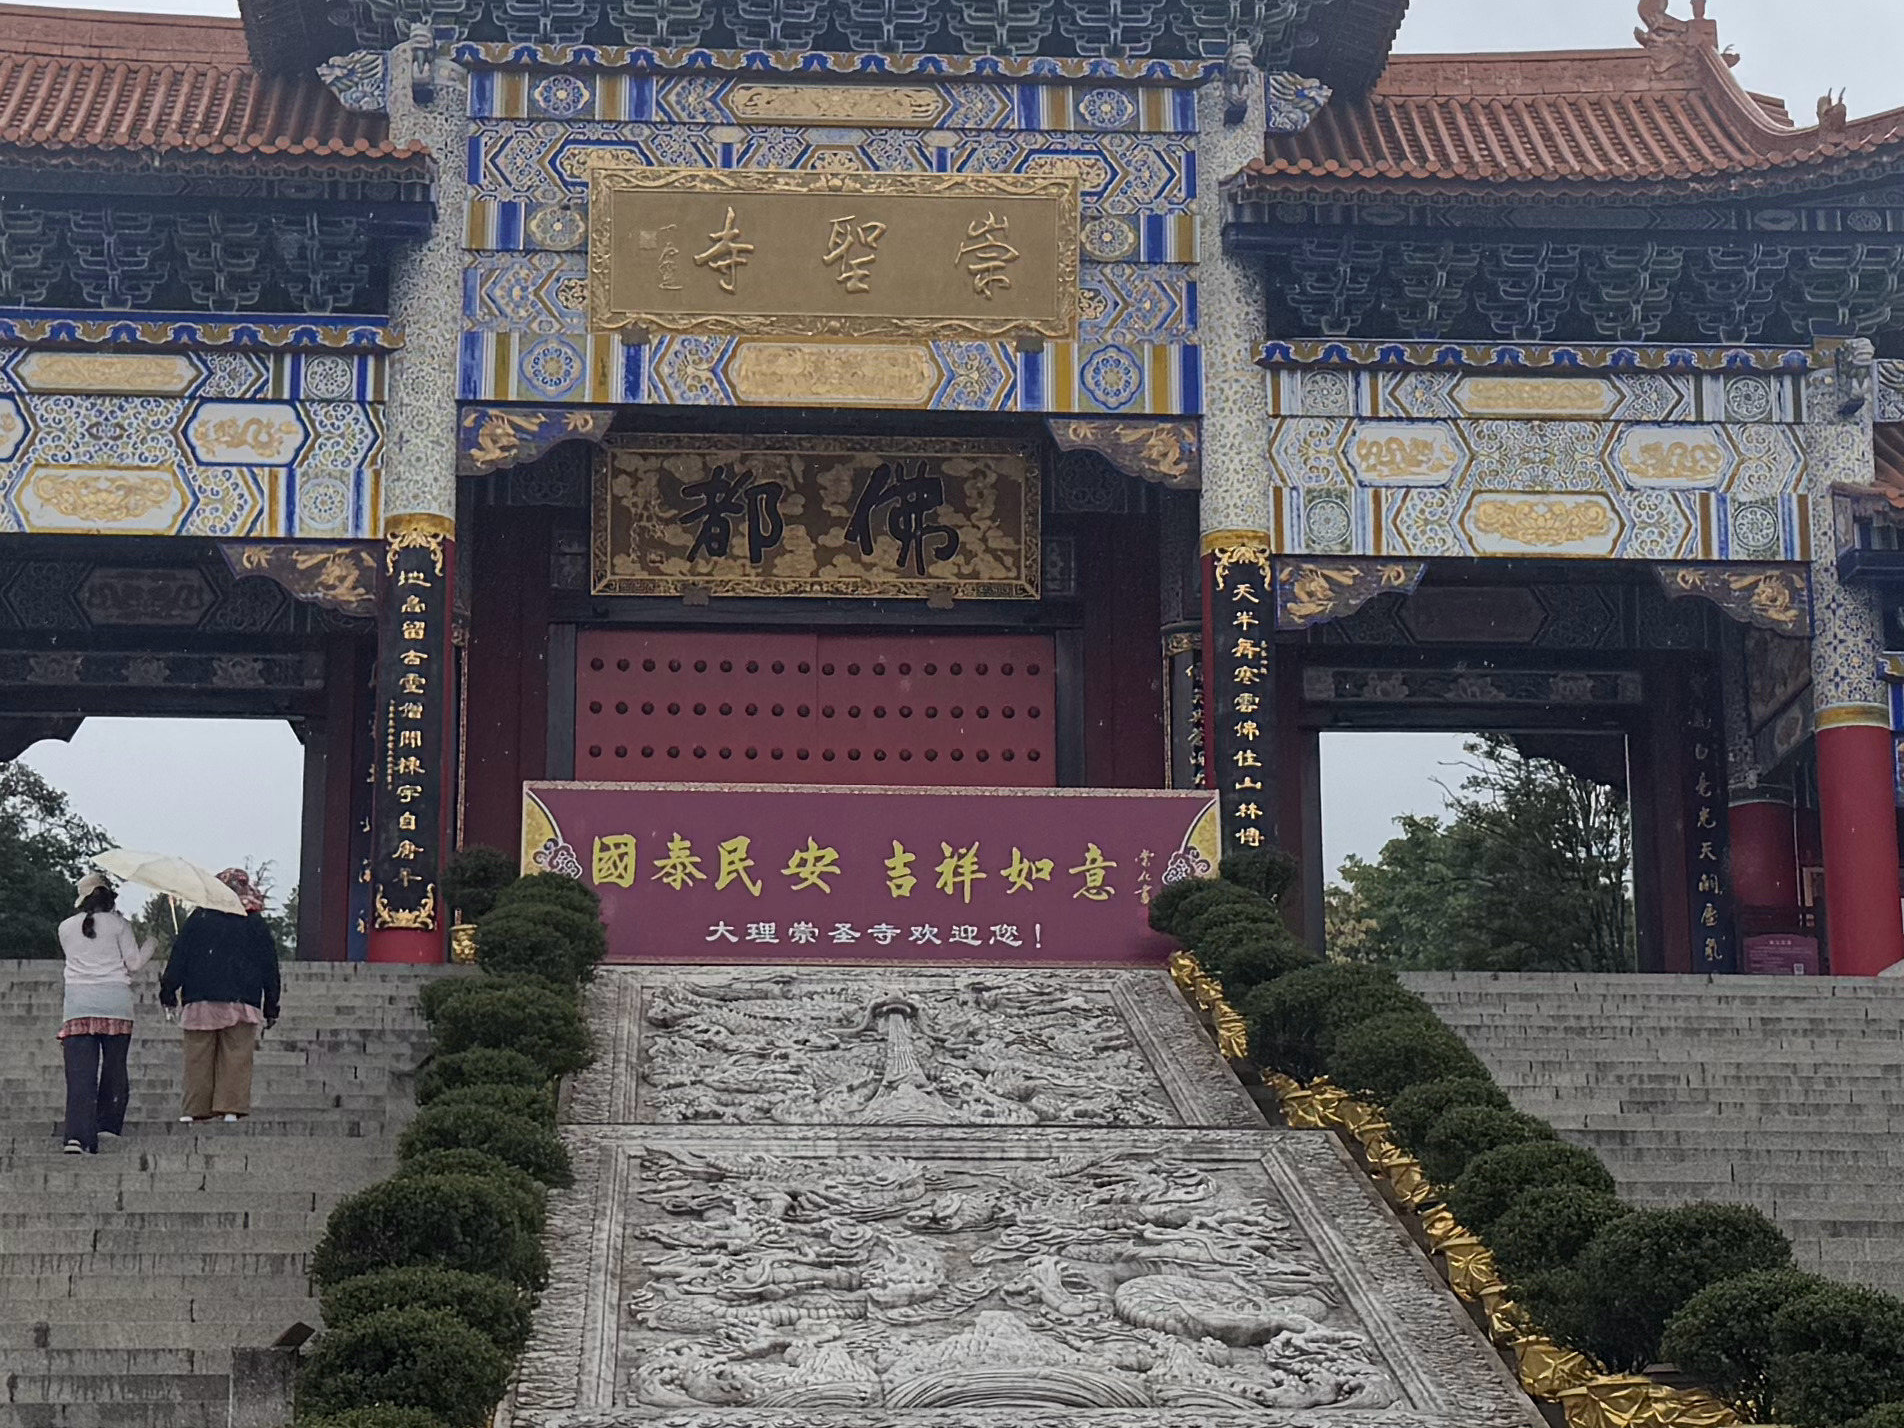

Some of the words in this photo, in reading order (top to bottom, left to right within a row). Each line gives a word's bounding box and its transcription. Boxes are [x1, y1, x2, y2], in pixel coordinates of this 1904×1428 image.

[590, 832, 842, 897] 國泰民安
[882, 839, 1118, 904] 吉祥如意
